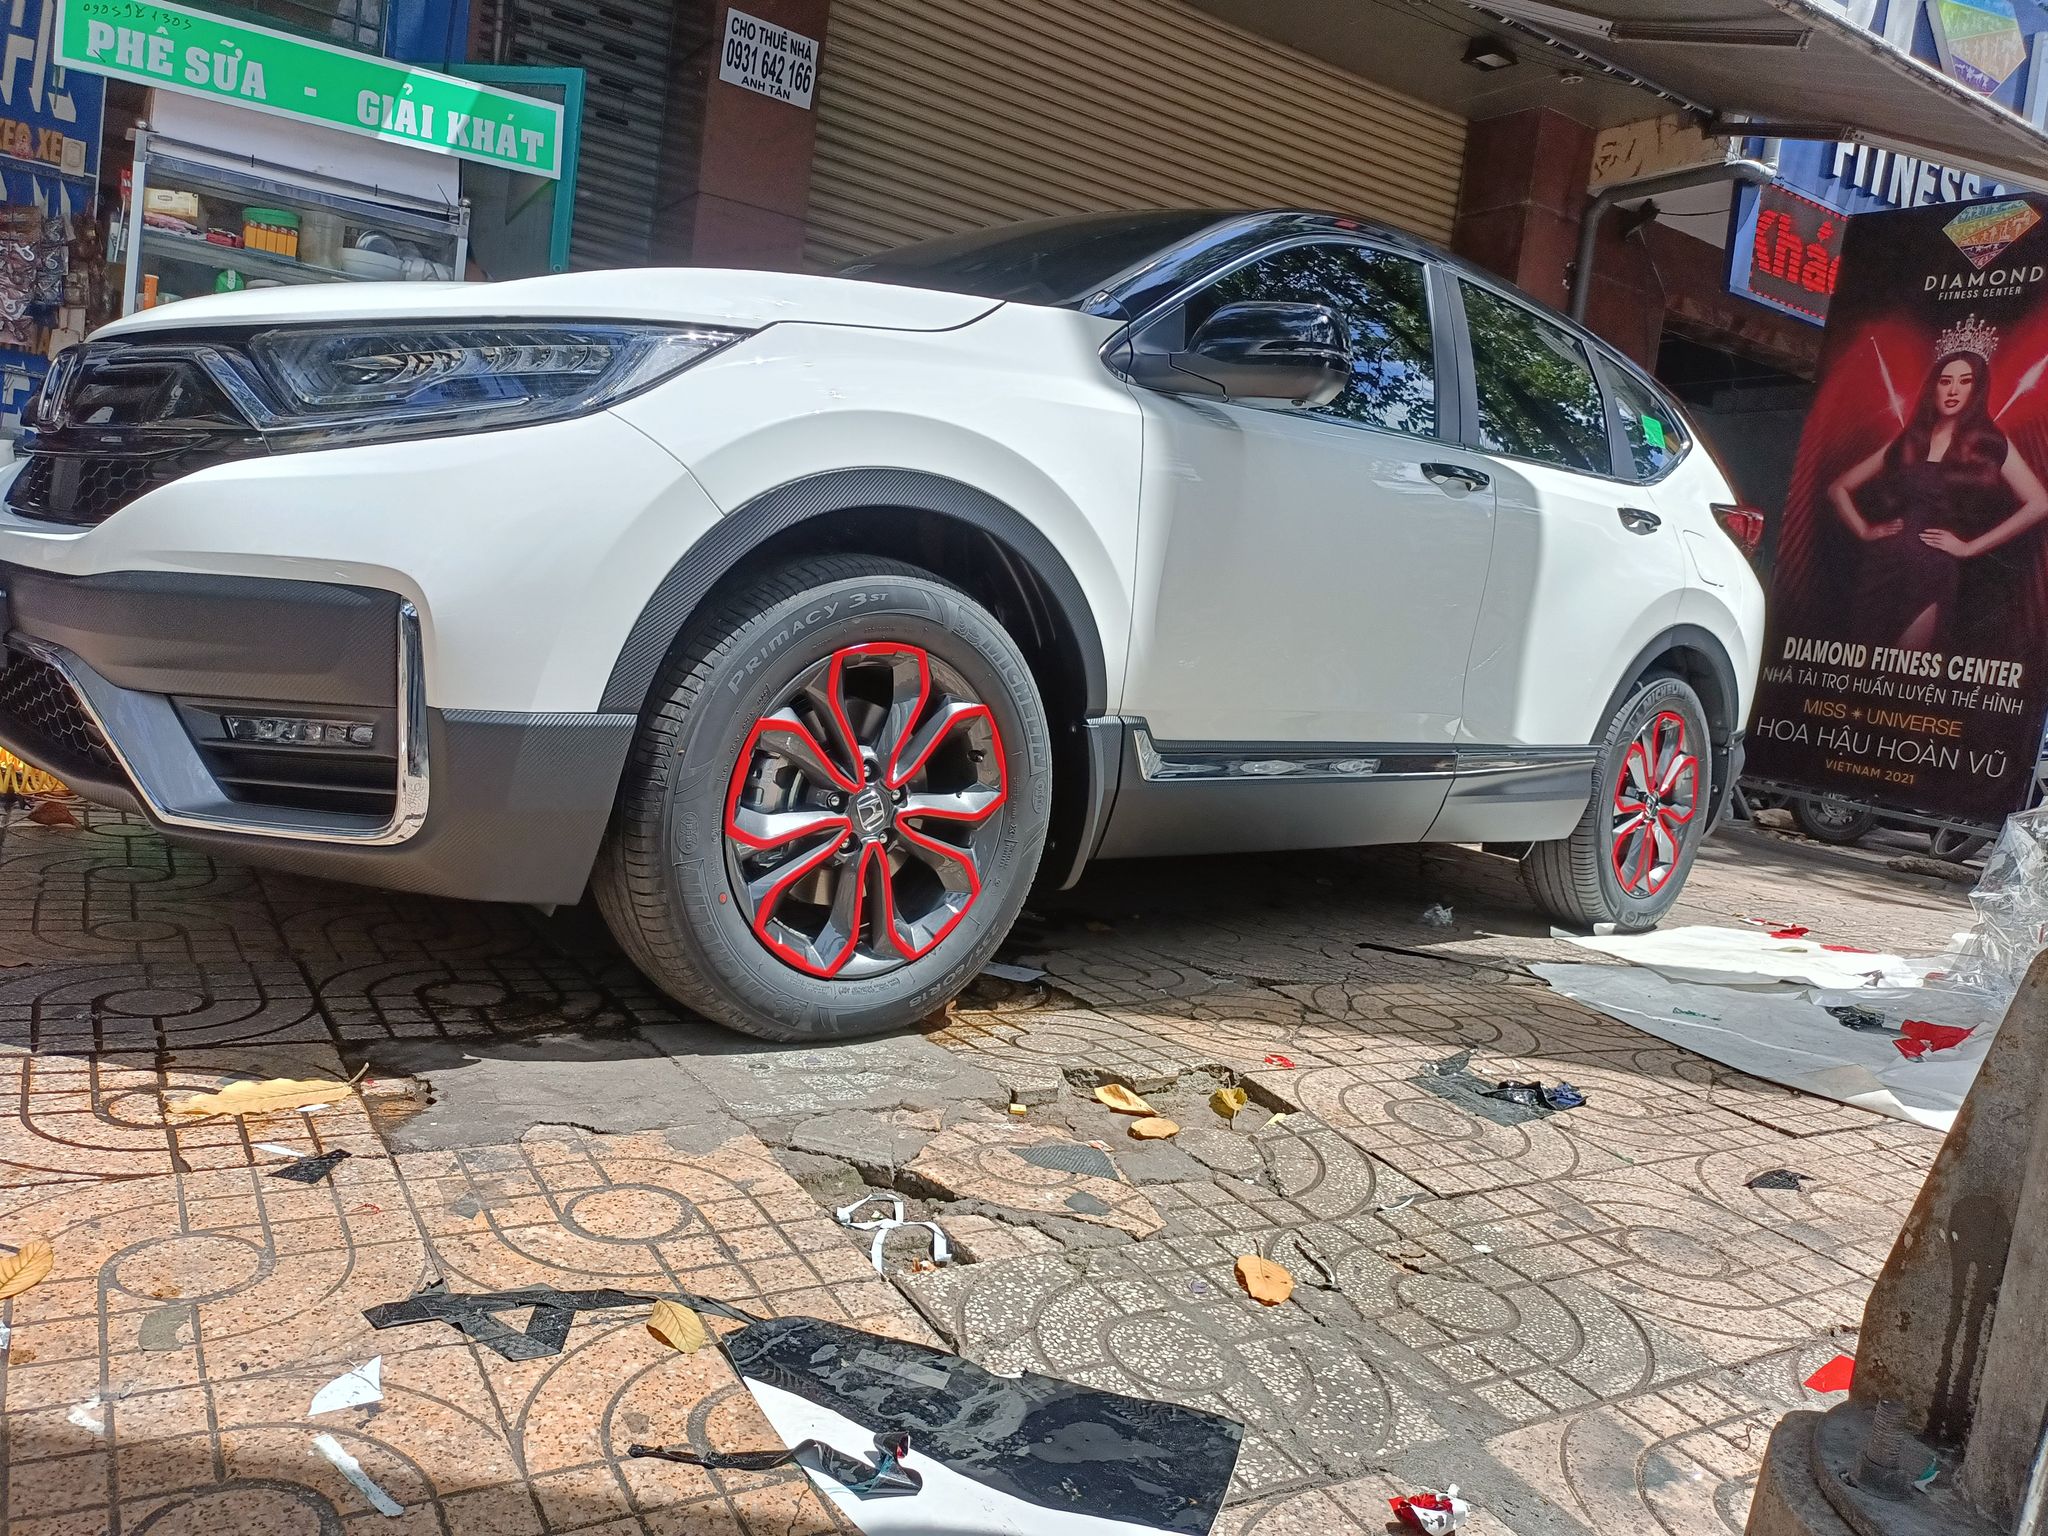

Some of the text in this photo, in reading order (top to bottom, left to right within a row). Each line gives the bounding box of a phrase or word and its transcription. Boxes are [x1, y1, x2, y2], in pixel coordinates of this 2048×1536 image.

[731, 17, 812, 62] CHO THUÊ NHÀ
[726, 38, 812, 94] 0931 642 166
[741, 76, 766, 92] ANH
[86, 19, 175, 76] PHÊ
[184, 39, 267, 100] SỮA
[357, 83, 434, 140] GIẢI
[446, 111, 545, 163] KHÁT
[1924, 266, 2044, 291] DIAMOND
[1938, 286, 2021, 300] FITNESS CENTER
[1783, 636, 2023, 688] DIAMOND FITNESS CENTER
[1762, 665, 2023, 715] NHÀ TÀI TRỢ HUẤN LUYỆN THỂ HÌNH
[1803, 699, 1963, 737] MISS UNIVERSE
[1757, 716, 2007, 778] HOA HẬU HOÀN VŨ
[1826, 759, 1915, 785] VIETNAM 2021
